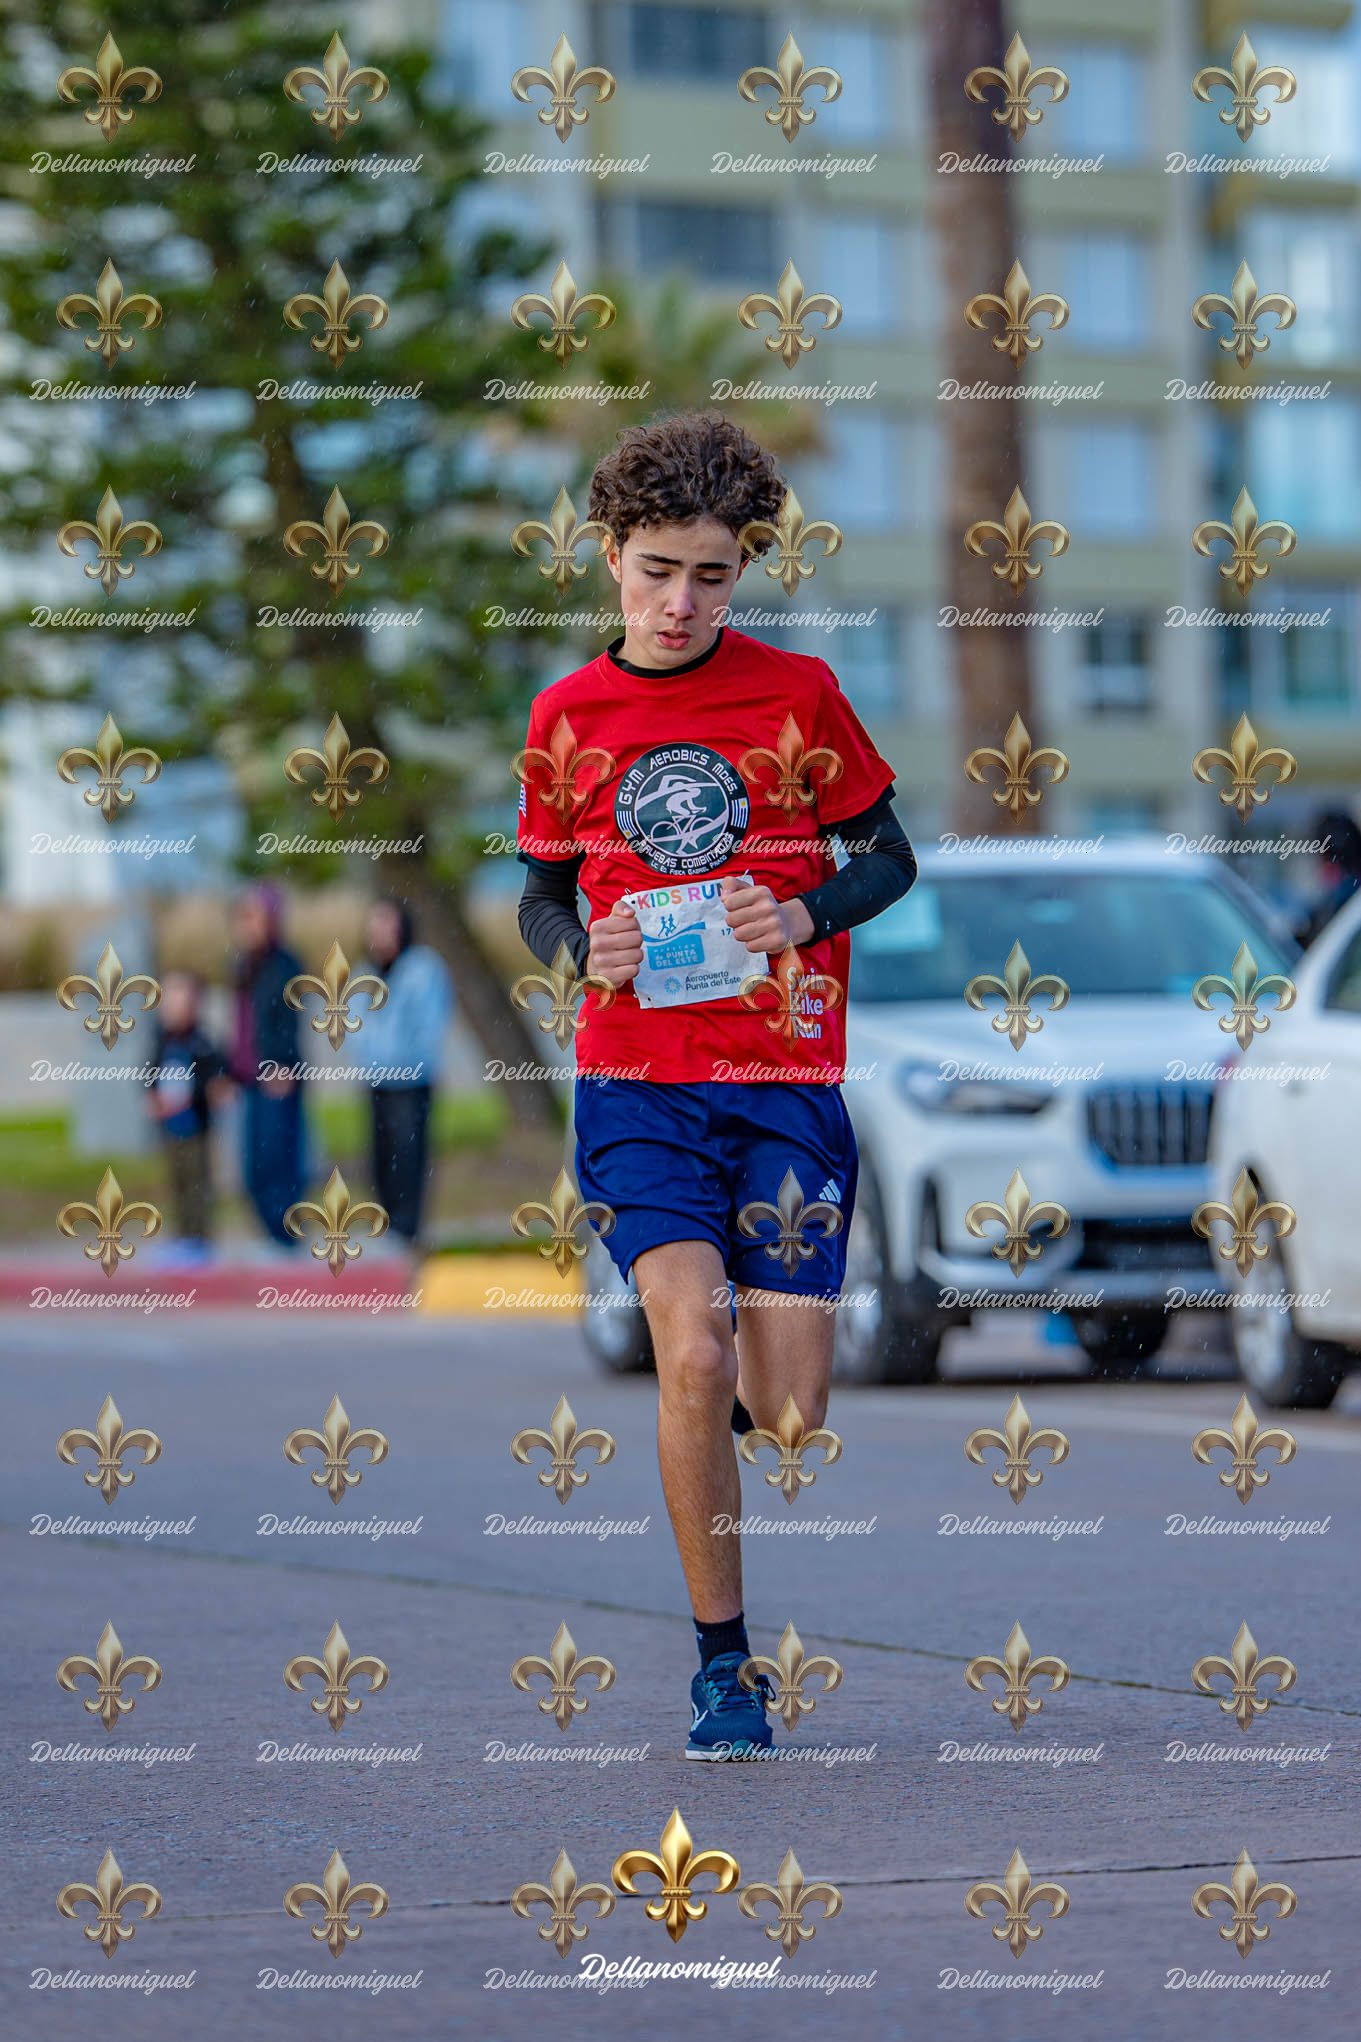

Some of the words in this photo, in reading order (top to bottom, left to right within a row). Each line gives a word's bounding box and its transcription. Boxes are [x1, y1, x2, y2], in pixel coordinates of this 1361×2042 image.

[618, 768, 646, 805] GYM
[649, 749, 710, 771] AEROBICS
[636, 839, 679, 868] PRUEBAS
[636, 888, 683, 910] KIDS
[685, 970, 729, 984] Aeropuerto
[685, 979, 709, 991] Punta
[710, 976, 723, 988] del
[724, 974, 742, 986] Este
